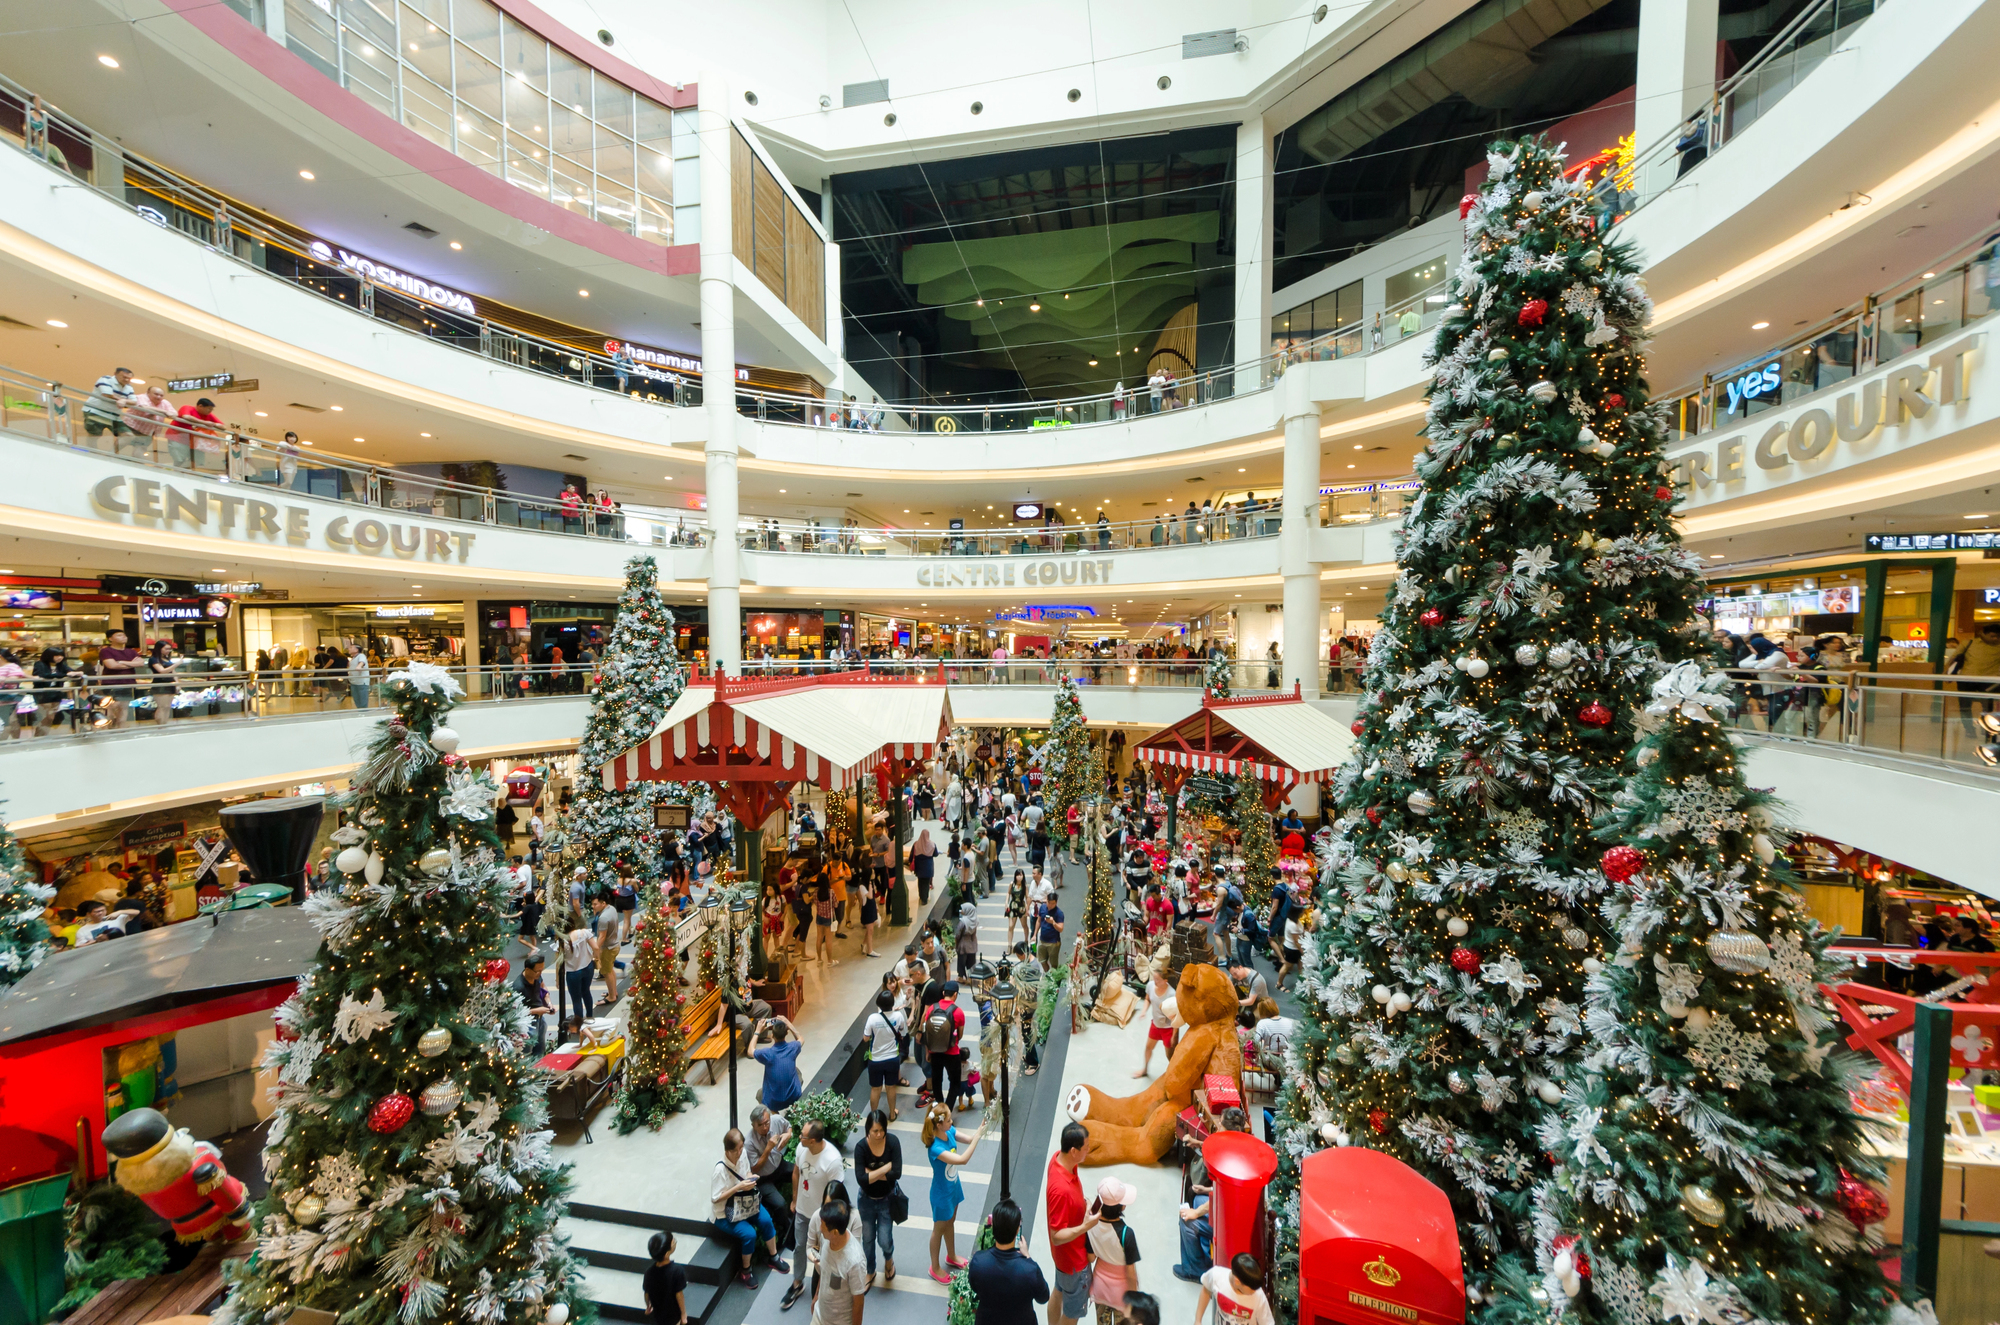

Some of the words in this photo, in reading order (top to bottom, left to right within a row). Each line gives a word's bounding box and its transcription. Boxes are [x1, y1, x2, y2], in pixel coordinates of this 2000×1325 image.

[338, 249, 476, 315] YOSHINOYA
[1725, 362, 1782, 415] yes
[1754, 332, 1985, 471] COURT
[389, 497, 445, 508] GoPro
[93, 475, 311, 541] CENTRE
[325, 515, 477, 558] COURT
[916, 562, 1015, 587] CENTRE
[1023, 559, 1114, 585] COURT
[376, 605, 436, 617] SmartMaster
[977, 749, 991, 757] STOP
[1192, 781, 1206, 789] Hello
[1206, 783, 1223, 792] Planet
[668, 815, 675, 825] 2
[128, 830, 181, 845] Redemption
[146, 827, 164, 835] Gift
[196, 843, 223, 878] CROSSING
[676, 927, 692, 945] MID
[1350, 1292, 1418, 1321] TELEPHONE
